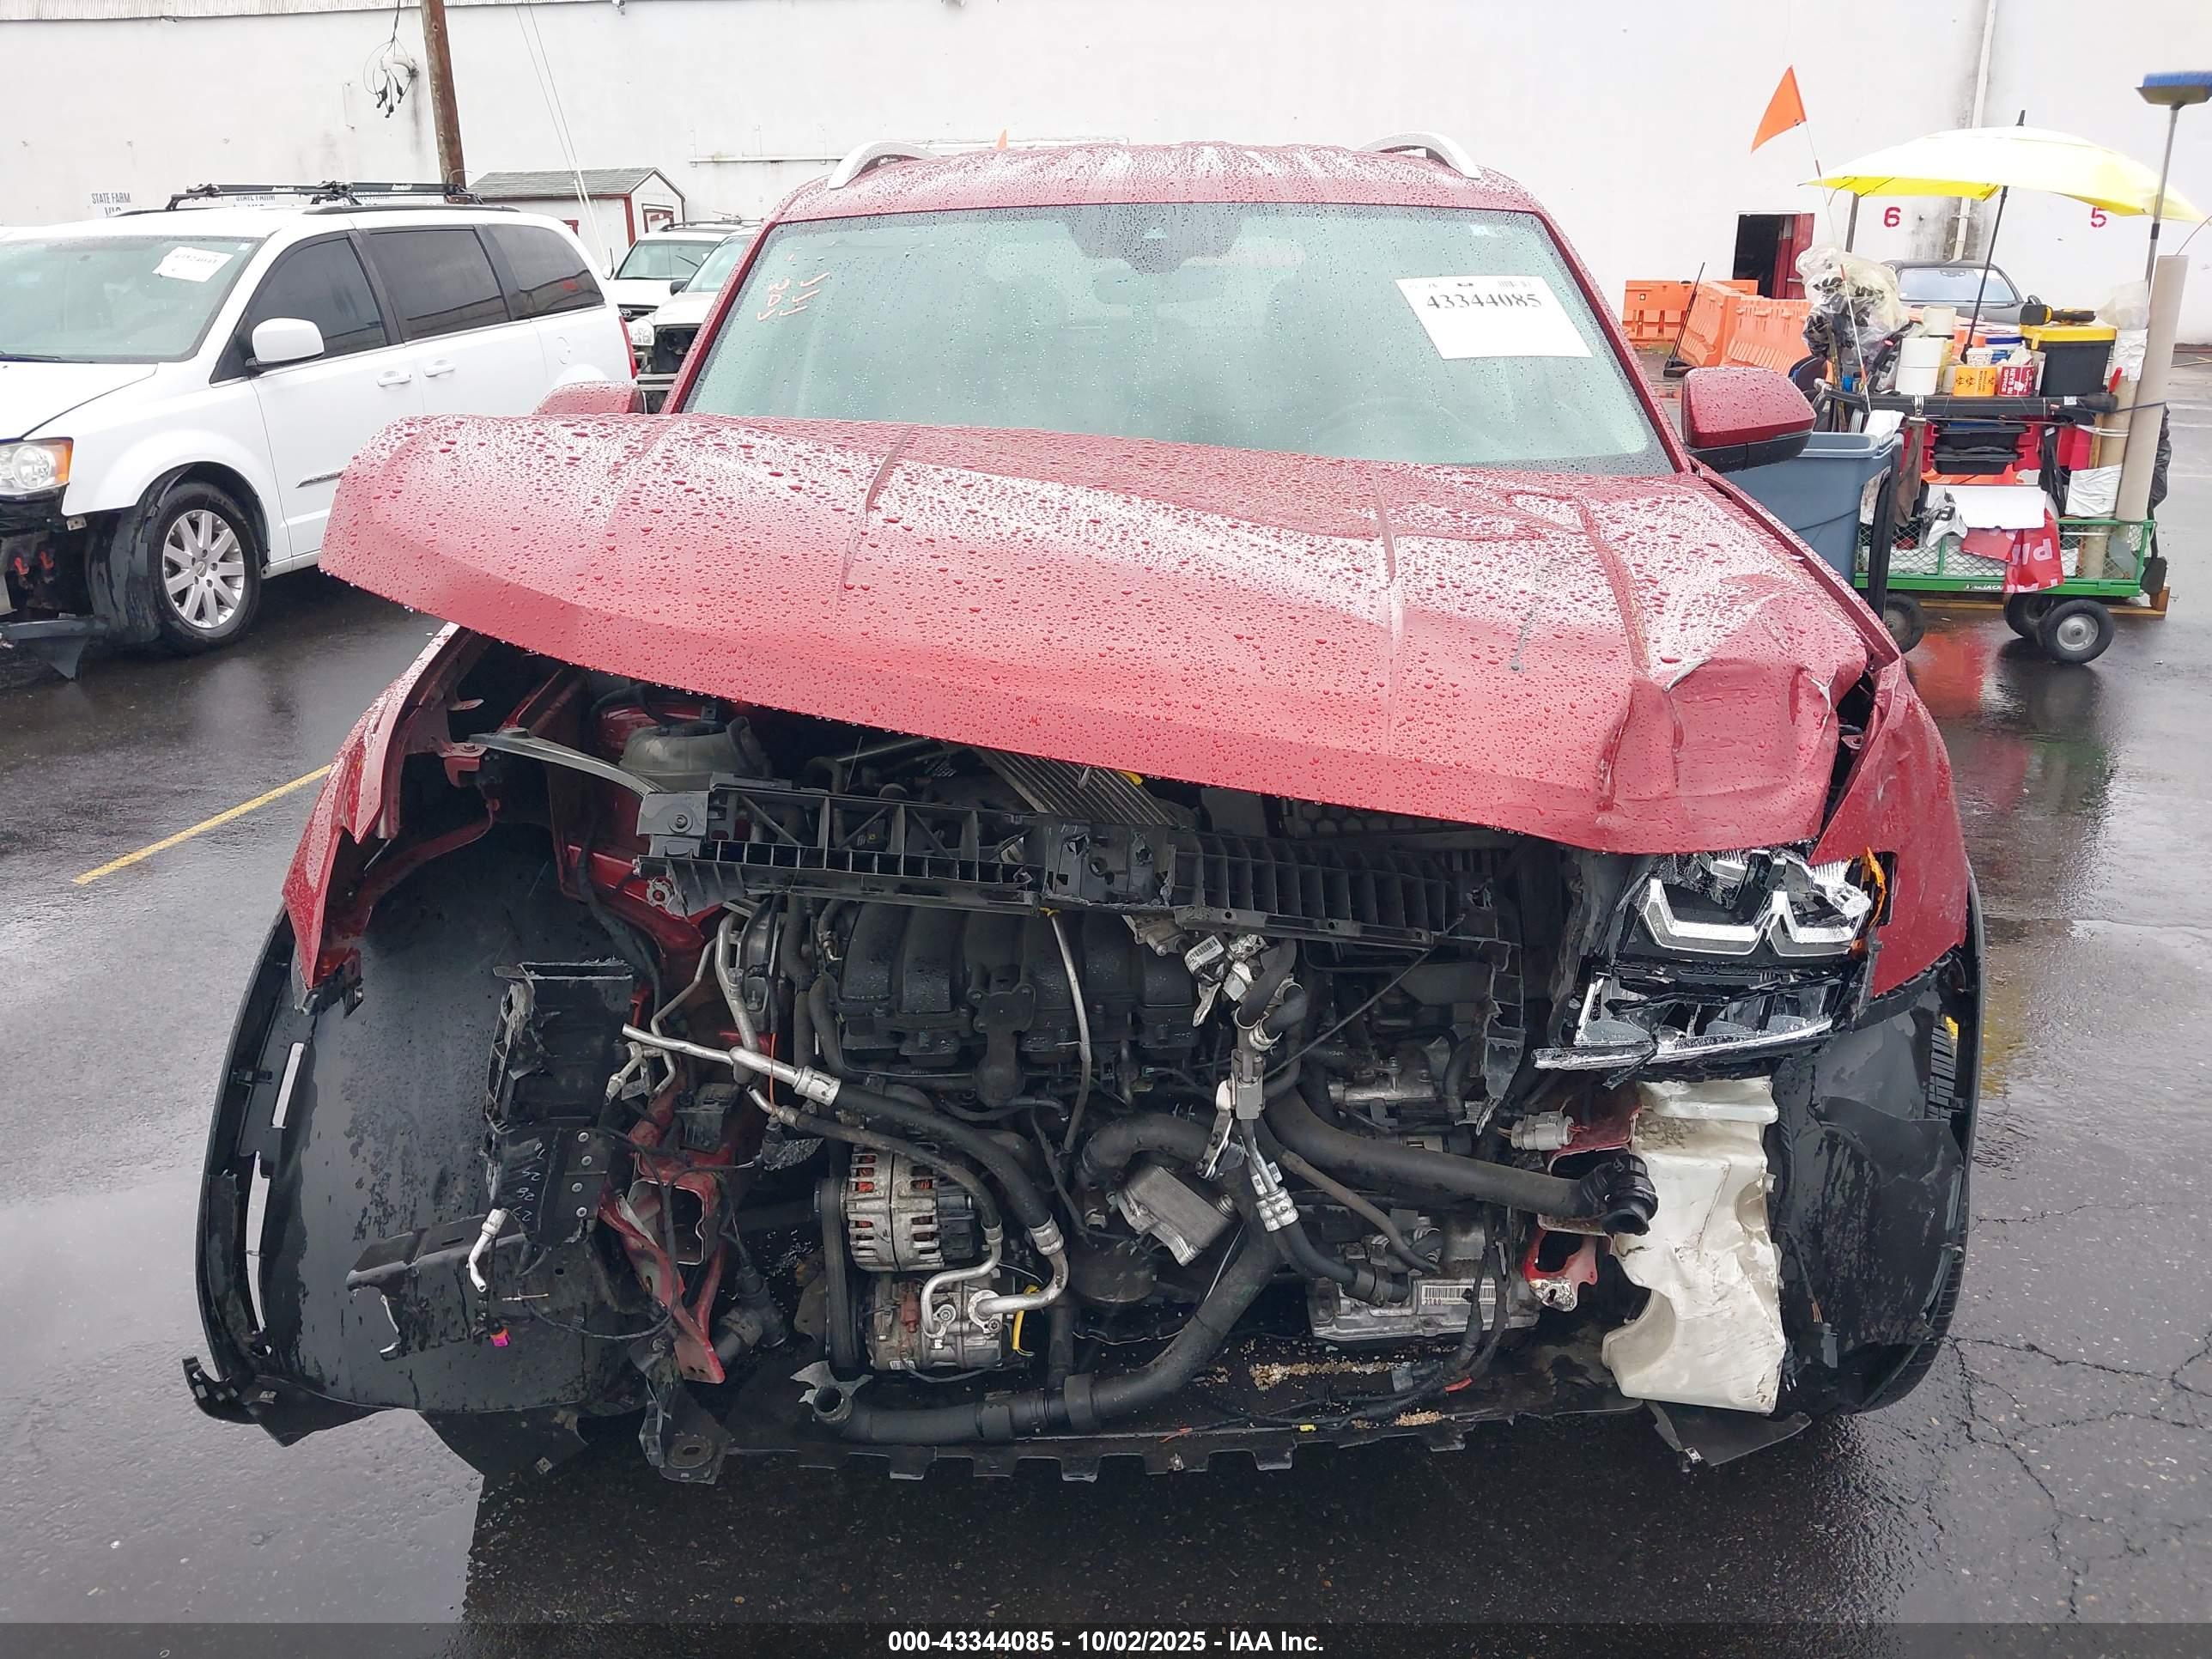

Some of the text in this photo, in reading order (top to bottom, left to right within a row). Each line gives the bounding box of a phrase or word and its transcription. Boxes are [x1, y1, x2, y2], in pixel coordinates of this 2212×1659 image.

[91, 191, 131, 204] STATE FARM
[1883, 206, 1901, 228] 6
[2090, 207, 2107, 228] 5
[1427, 294, 1542, 309] 43344085
